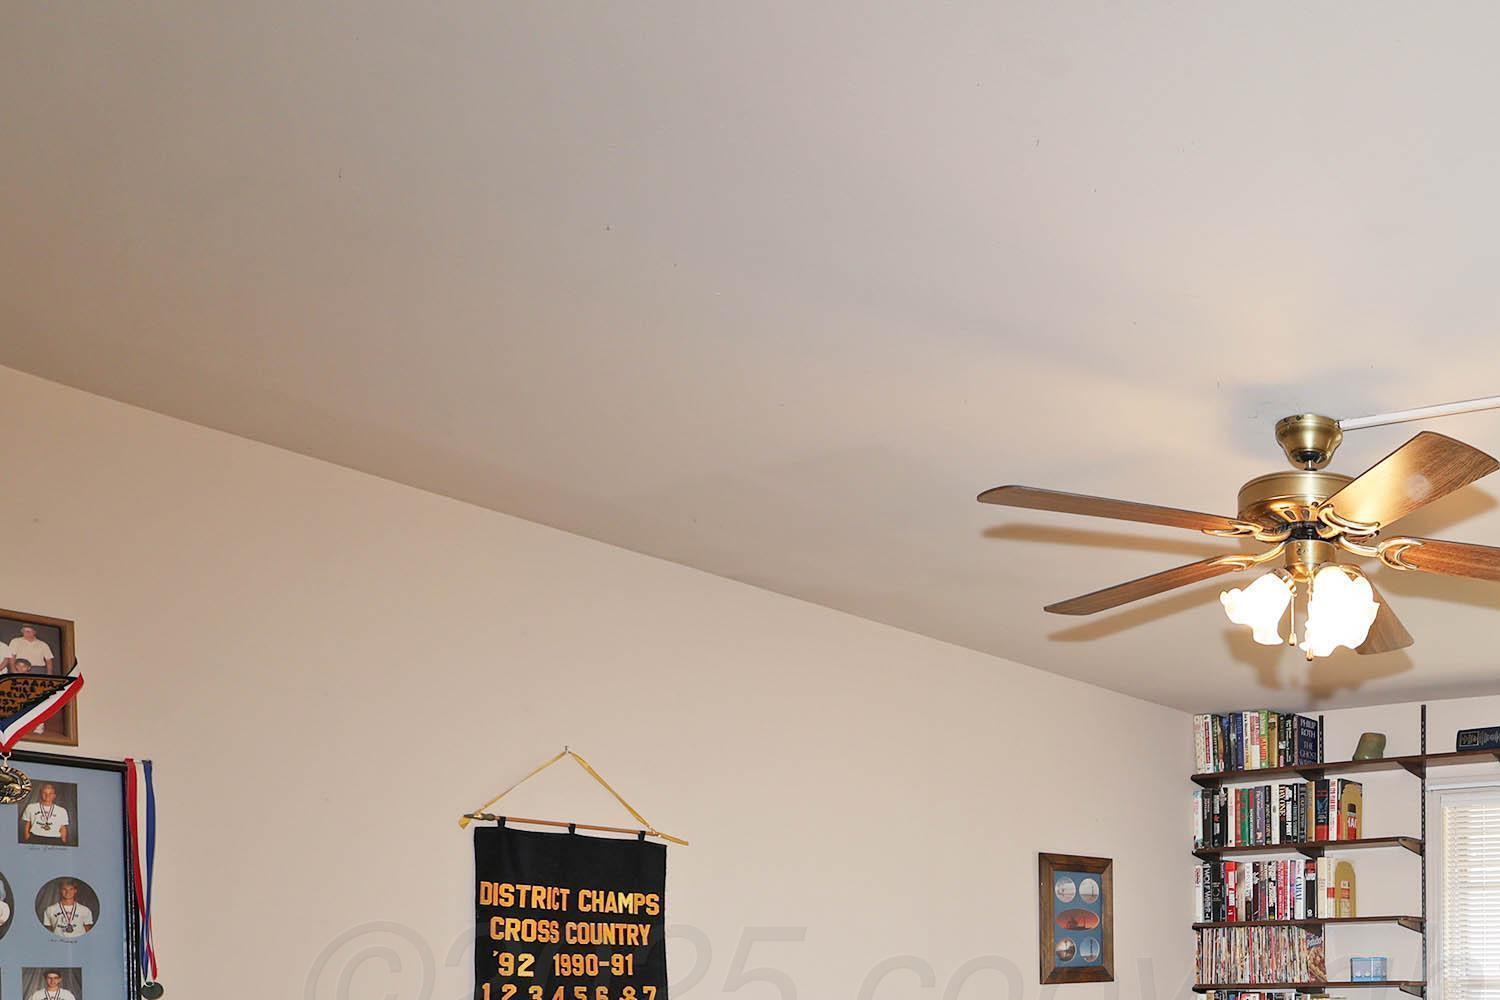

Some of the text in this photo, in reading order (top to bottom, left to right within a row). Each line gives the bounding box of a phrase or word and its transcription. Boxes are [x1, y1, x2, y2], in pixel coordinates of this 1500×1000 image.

[1300, 728, 1316, 738] ROTH
[479, 881, 660, 916] DISTRICT CHAMPS
[490, 916, 651, 946] CROSS COUNTRY
[492, 951, 634, 978] '92 1990-91
